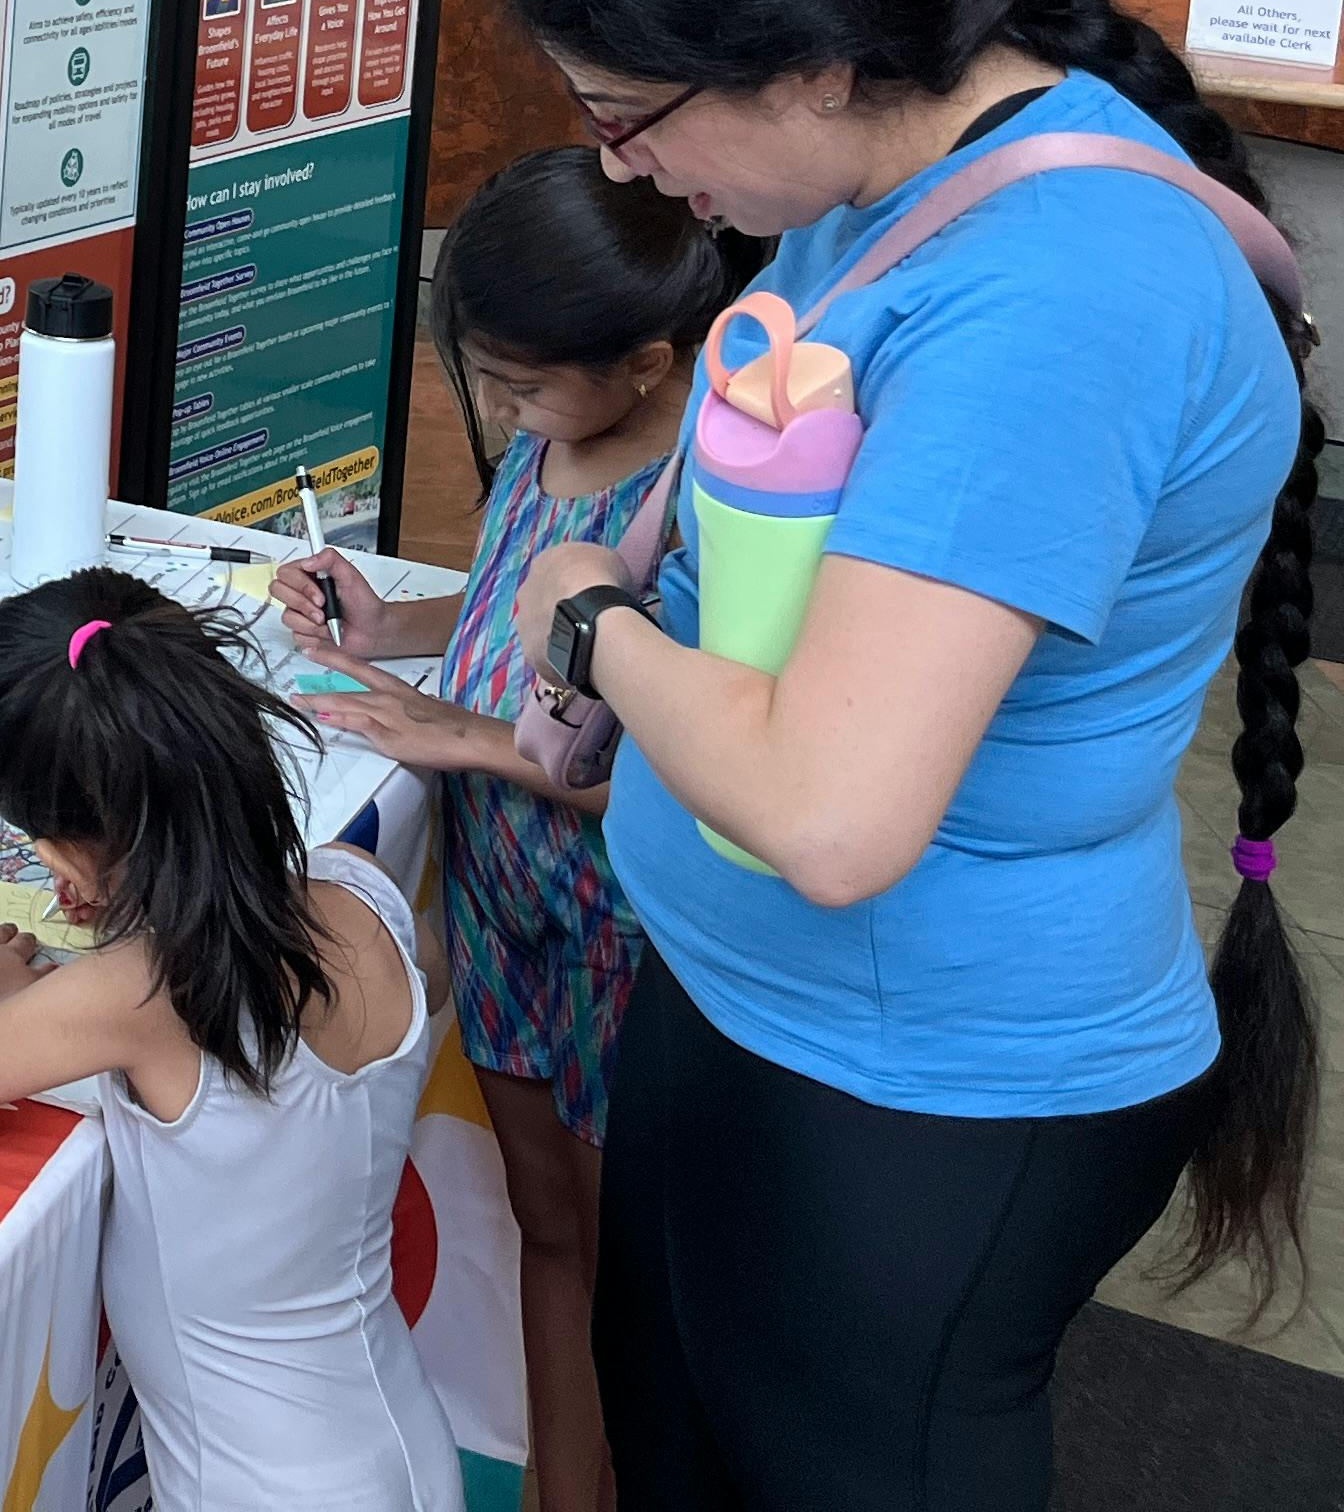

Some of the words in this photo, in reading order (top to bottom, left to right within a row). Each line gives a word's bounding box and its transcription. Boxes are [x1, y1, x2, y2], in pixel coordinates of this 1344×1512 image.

[1236, 5, 1253, 16] All
[1257, 7, 1301, 22] Others,
[1209, 16, 1250, 29] please
[1252, 23, 1279, 33] wait
[1282, 24, 1300, 35] for
[1304, 28, 1331, 40] next
[1221, 32, 1276, 47] available
[1279, 38, 1312, 51] Clerk
[209, 188, 230, 205] can
[238, 180, 263, 198] stay
[264, 162, 315, 190] involved?
